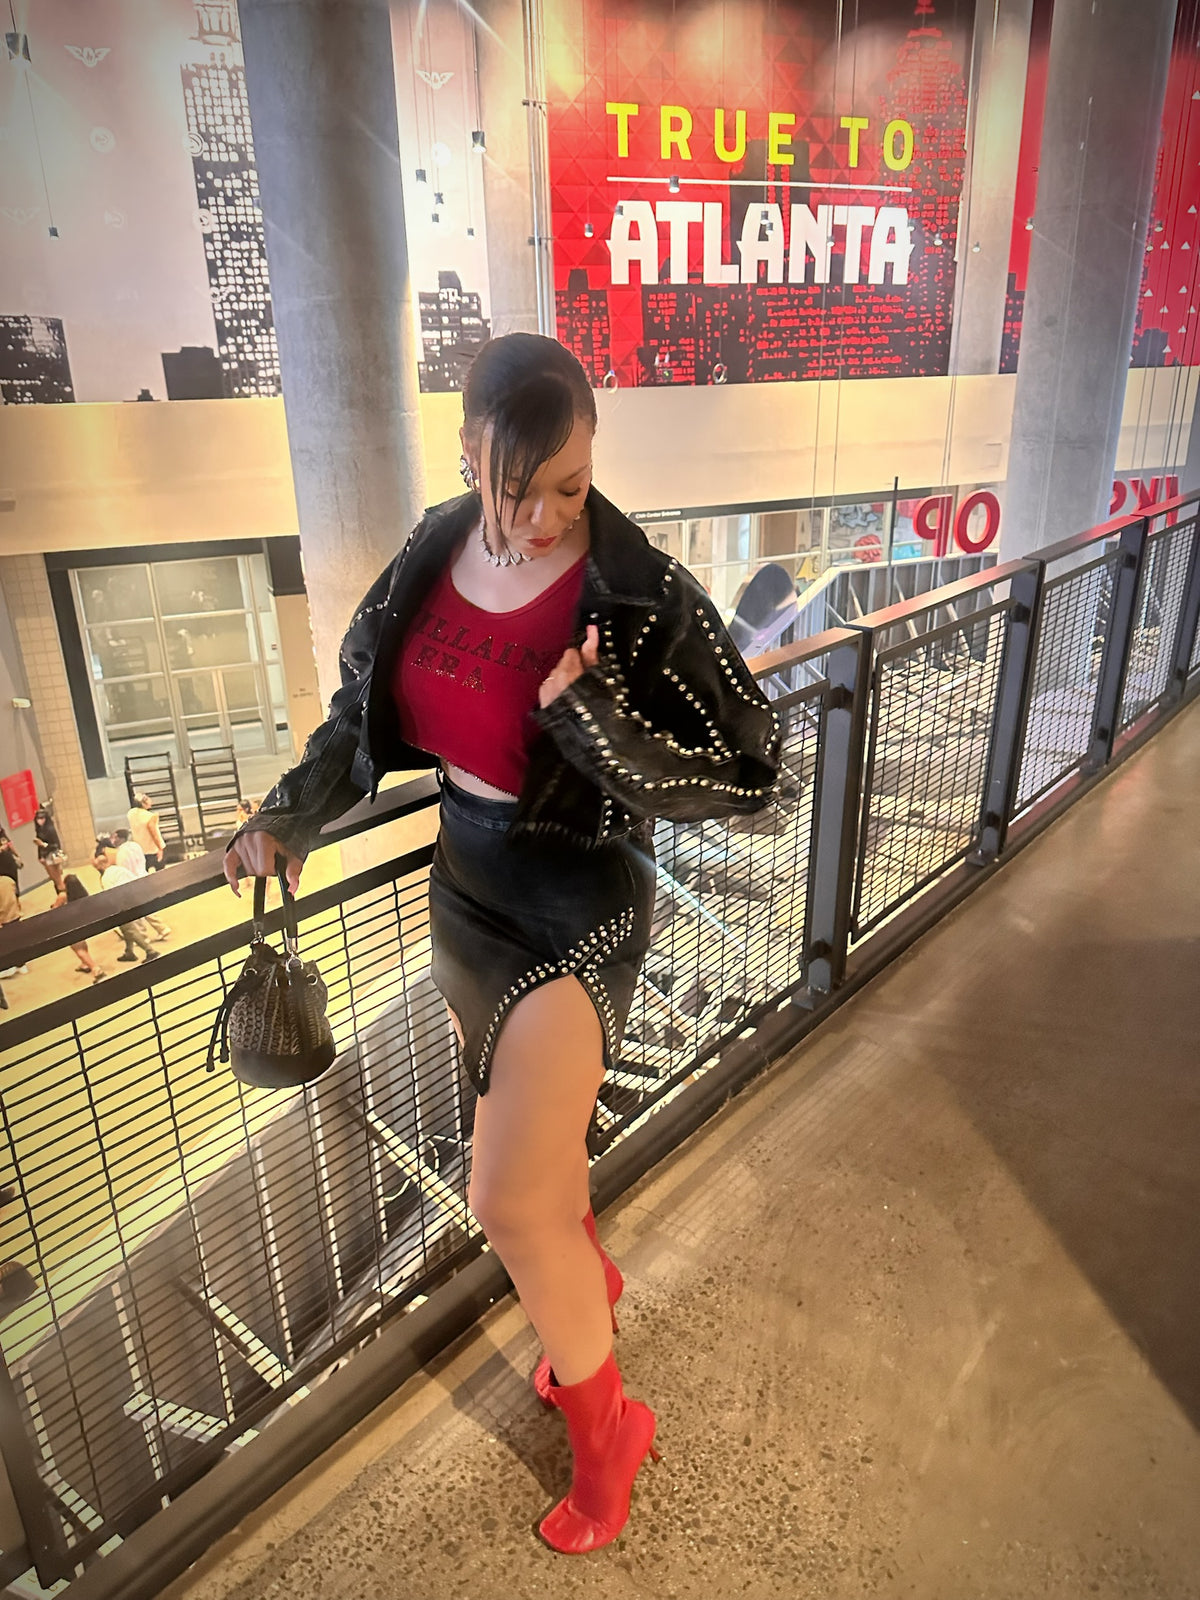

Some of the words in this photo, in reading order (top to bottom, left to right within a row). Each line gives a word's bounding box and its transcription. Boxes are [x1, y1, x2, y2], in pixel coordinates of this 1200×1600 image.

[605, 101, 796, 166] TRUE
[840, 116, 915, 171] TO
[605, 200, 915, 286] ATLANTA
[410, 644, 488, 693] ERA
